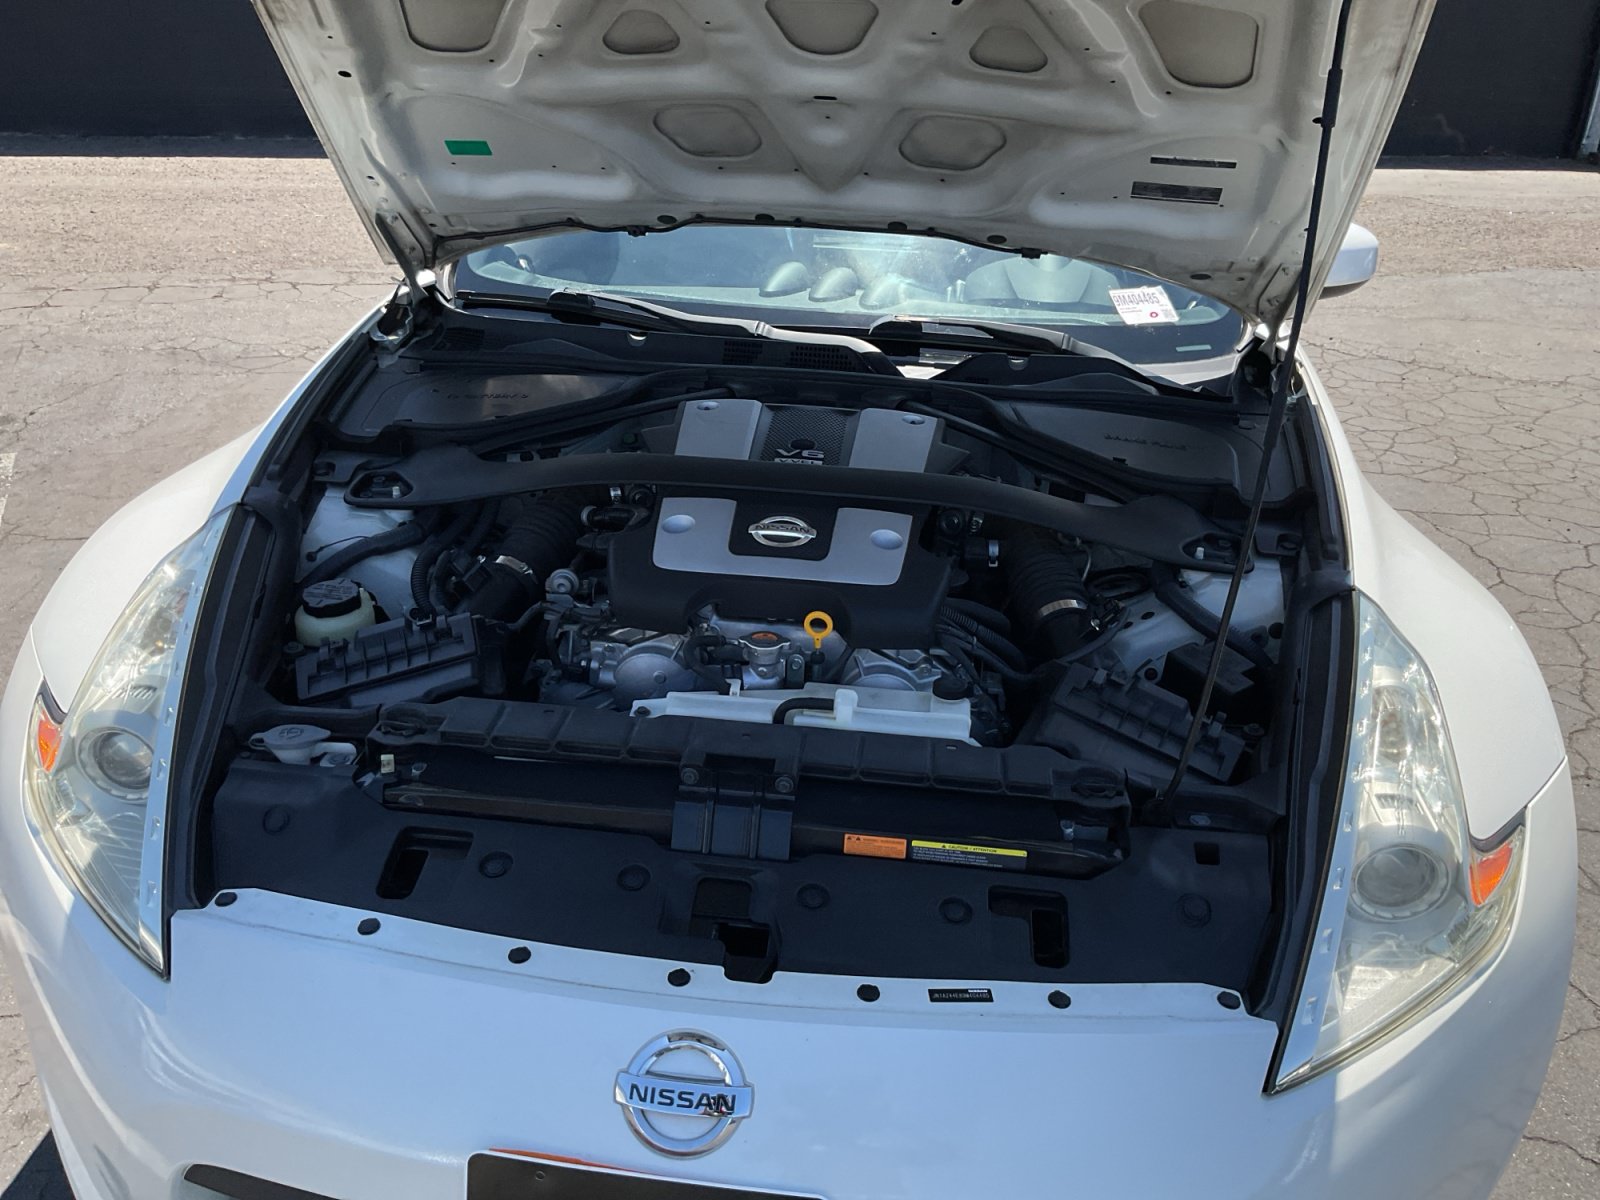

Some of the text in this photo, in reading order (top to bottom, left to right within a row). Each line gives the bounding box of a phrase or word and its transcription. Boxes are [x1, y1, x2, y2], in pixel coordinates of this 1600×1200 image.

[1112, 291, 1160, 306] 9M404485
[776, 449, 825, 458] V6
[755, 524, 810, 533] NISSAN
[629, 1083, 736, 1113] NISSAN
